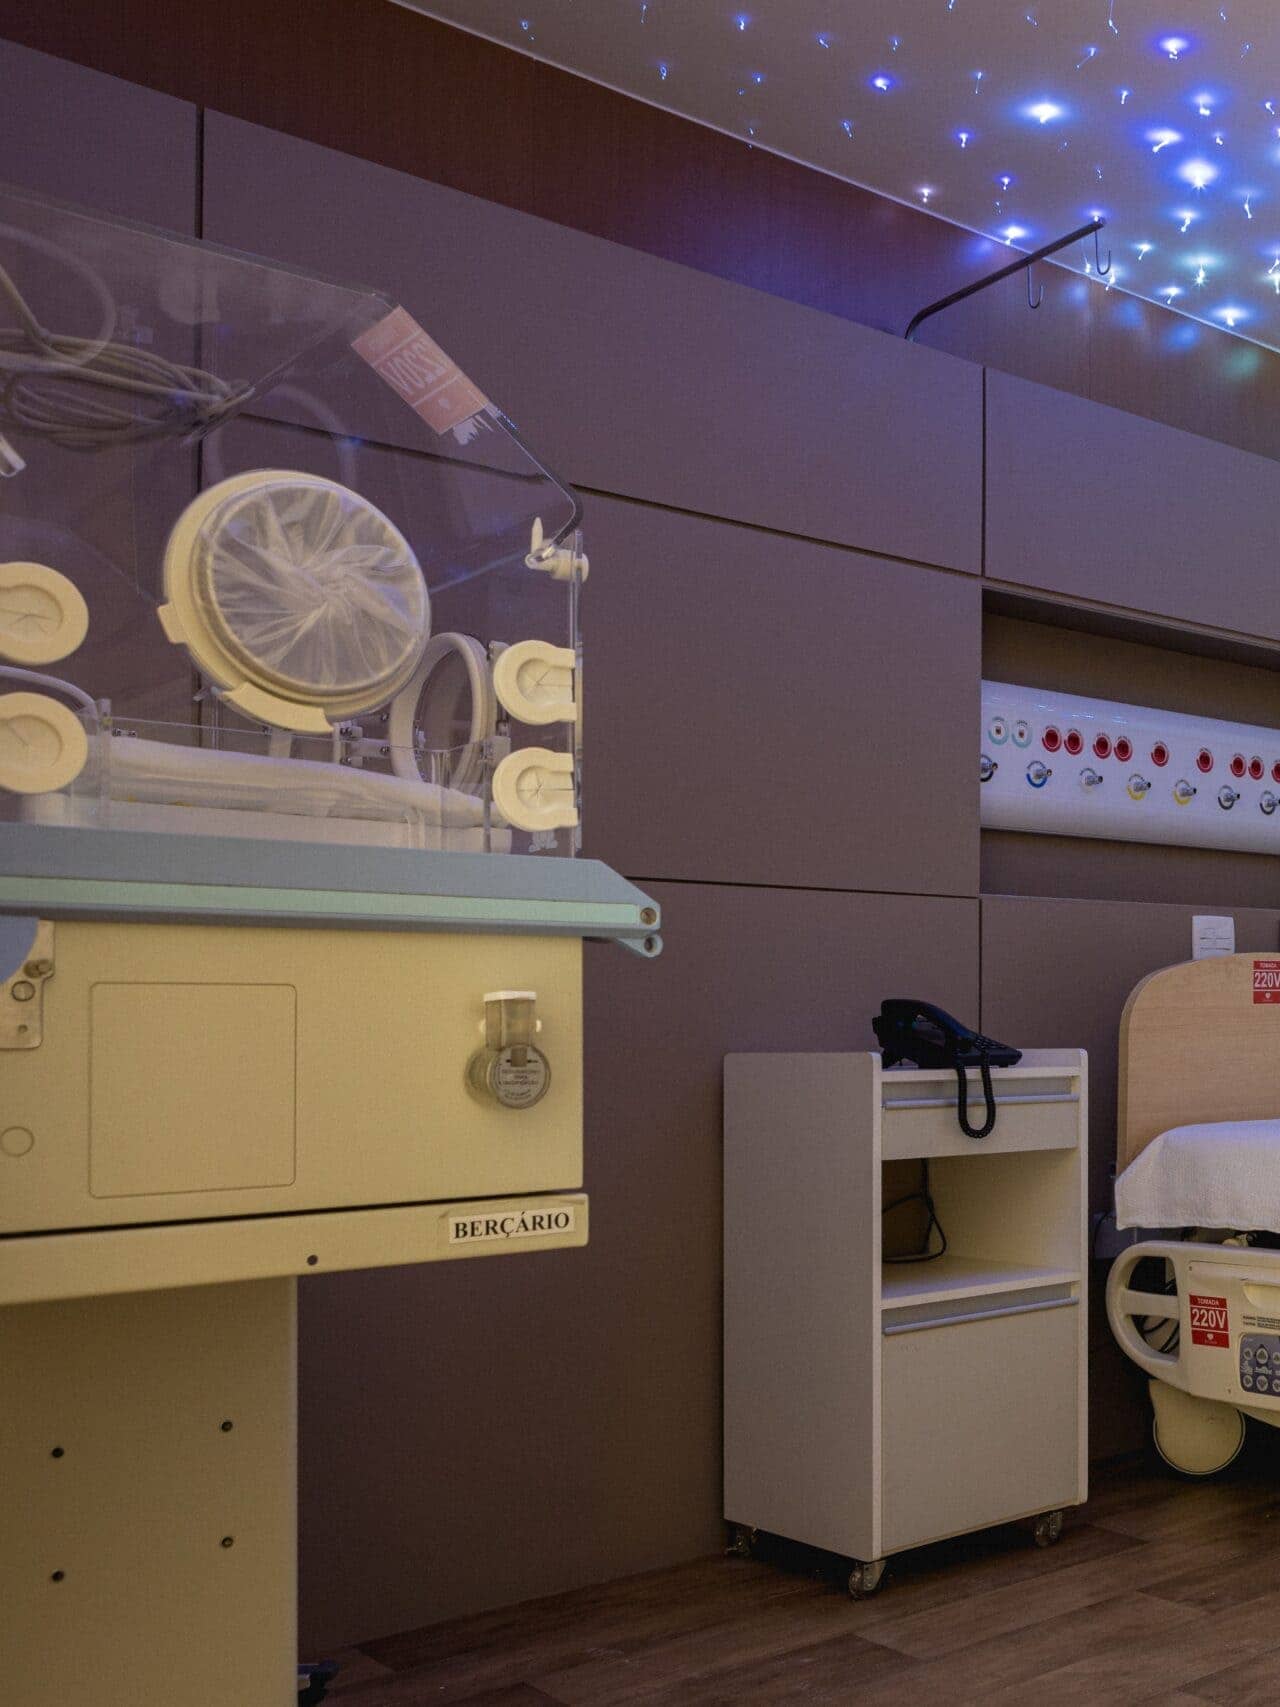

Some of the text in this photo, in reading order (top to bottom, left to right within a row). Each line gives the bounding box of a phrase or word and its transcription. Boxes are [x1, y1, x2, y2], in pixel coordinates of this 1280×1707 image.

[453, 1211, 570, 1240] BERÇÁRIO
[1197, 1298, 1220, 1306] TOMADA
[1191, 1308, 1226, 1328] 220V
